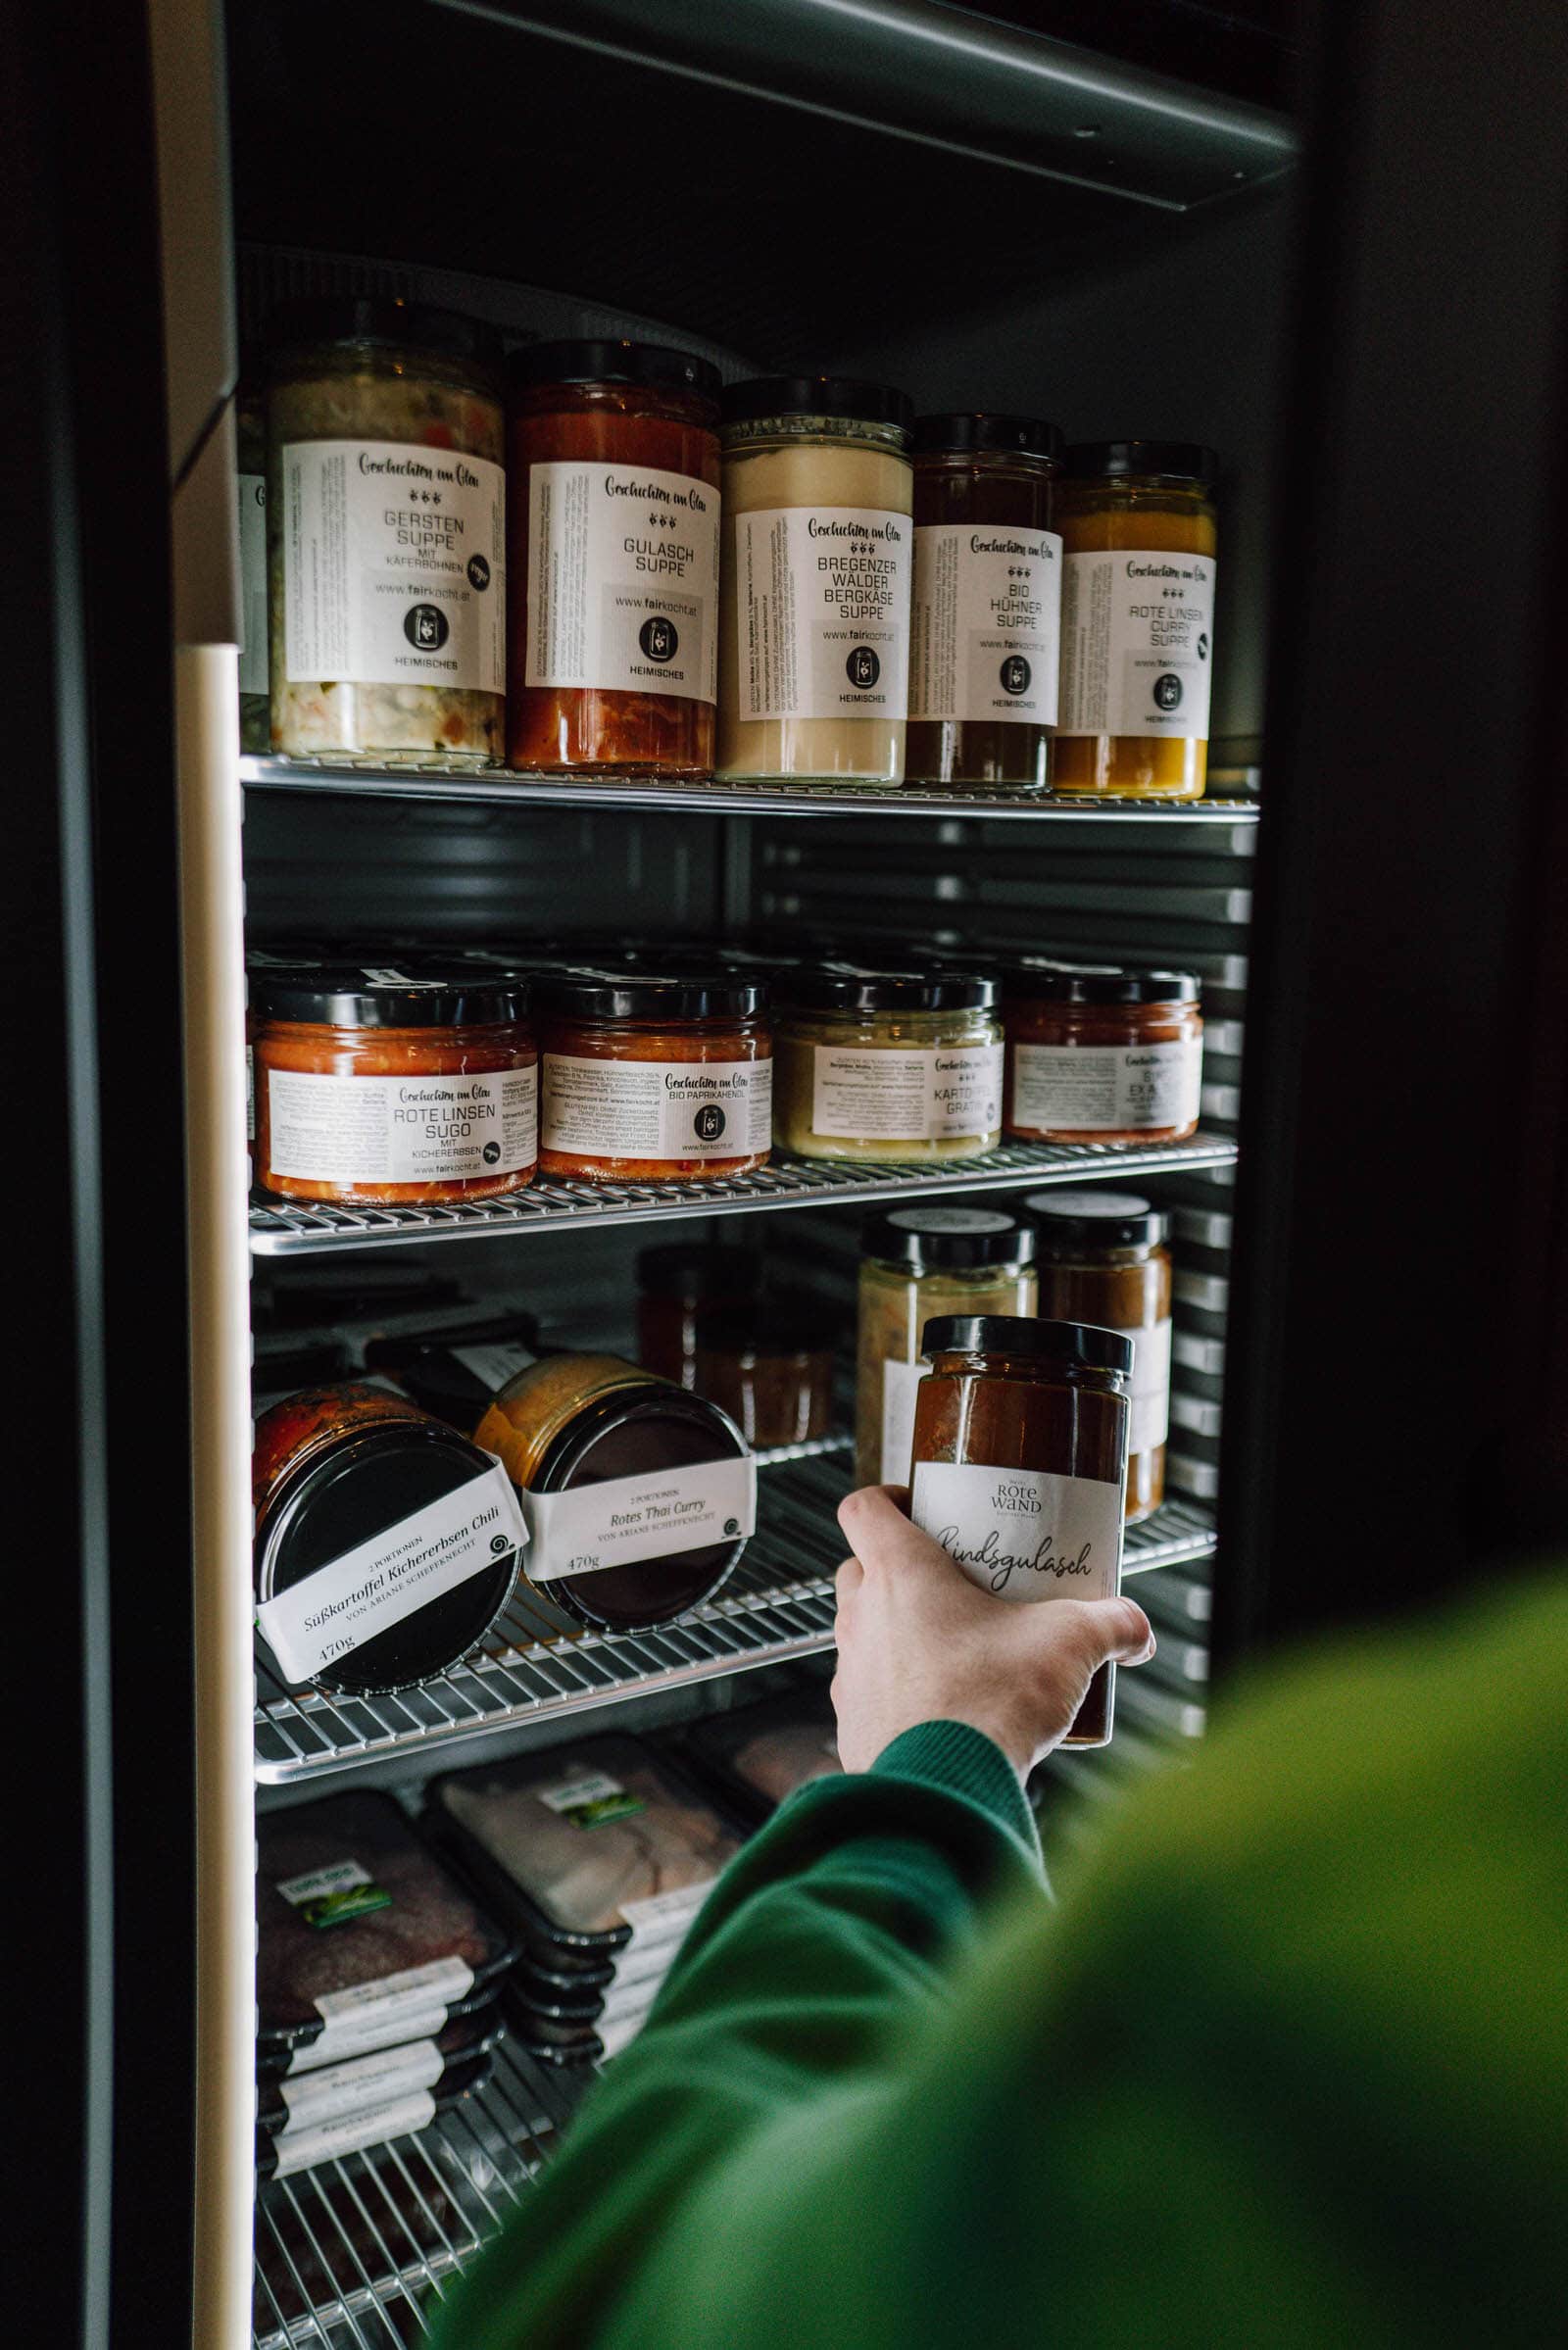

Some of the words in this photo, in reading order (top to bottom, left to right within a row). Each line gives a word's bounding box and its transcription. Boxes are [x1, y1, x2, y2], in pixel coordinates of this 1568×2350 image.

[359, 452, 433, 481] Geschichten
[605, 475, 670, 506] Geschichten
[384, 511, 465, 533] GERSTEN
[397, 529, 456, 551] SUPPE
[417, 549, 436, 560] MIT
[623, 538, 694, 562] GULASCH
[635, 557, 685, 577] SUPPE
[818, 557, 897, 573] BREGENZER
[832, 571, 888, 588] WÄLDER
[375, 583, 470, 602] www.fairkocht.at
[824, 589, 894, 606] BERGKÄSE
[1008, 584, 1029, 598] BIO
[615, 597, 698, 617] www.fairkocht.at
[840, 605, 884, 619] SUPPE
[990, 596, 1043, 614] HÜHNER
[1129, 606, 1166, 619] ROTE
[997, 614, 1037, 629] SUPPE
[1151, 620, 1192, 634] CURRY
[1151, 634, 1191, 648] SUPPE
[395, 658, 458, 671] HEIMISCHES
[630, 665, 684, 680] HEIMISCHES
[839, 694, 886, 704] HEIMISCHES
[668, 1090, 685, 1100] BIO
[687, 1090, 746, 1101] PAPRIKAHENDL
[934, 1087, 991, 1101] KARTO
[394, 1107, 439, 1123] ROTE
[442, 1103, 496, 1121] LINSEN
[947, 1100, 982, 1115] GRAT
[425, 1123, 471, 1139] SUGO
[440, 1139, 457, 1148] MIT
[412, 1147, 482, 1159] KICHERERBSEN
[414, 1162, 481, 1175] www.fairkocht.at
[611, 1511, 642, 1527] Rotes
[646, 1505, 670, 1519] Thai
[673, 1499, 706, 1514] Curry
[598, 1533, 616, 1542] VON
[618, 1525, 650, 1538] ARIANE
[374, 1536, 424, 1569] PORTIONEN
[304, 1574, 385, 1632] Süßkartoffel
[388, 1525, 468, 1582] Kichererbsen
[471, 1505, 500, 1531] Chili
[567, 1555, 600, 1570] 470g
[346, 1606, 368, 1623] VON
[369, 1585, 405, 1609] ARIANE
[406, 1539, 477, 1587] SCHEFFKNECHT
[318, 1635, 356, 1661] 470g
